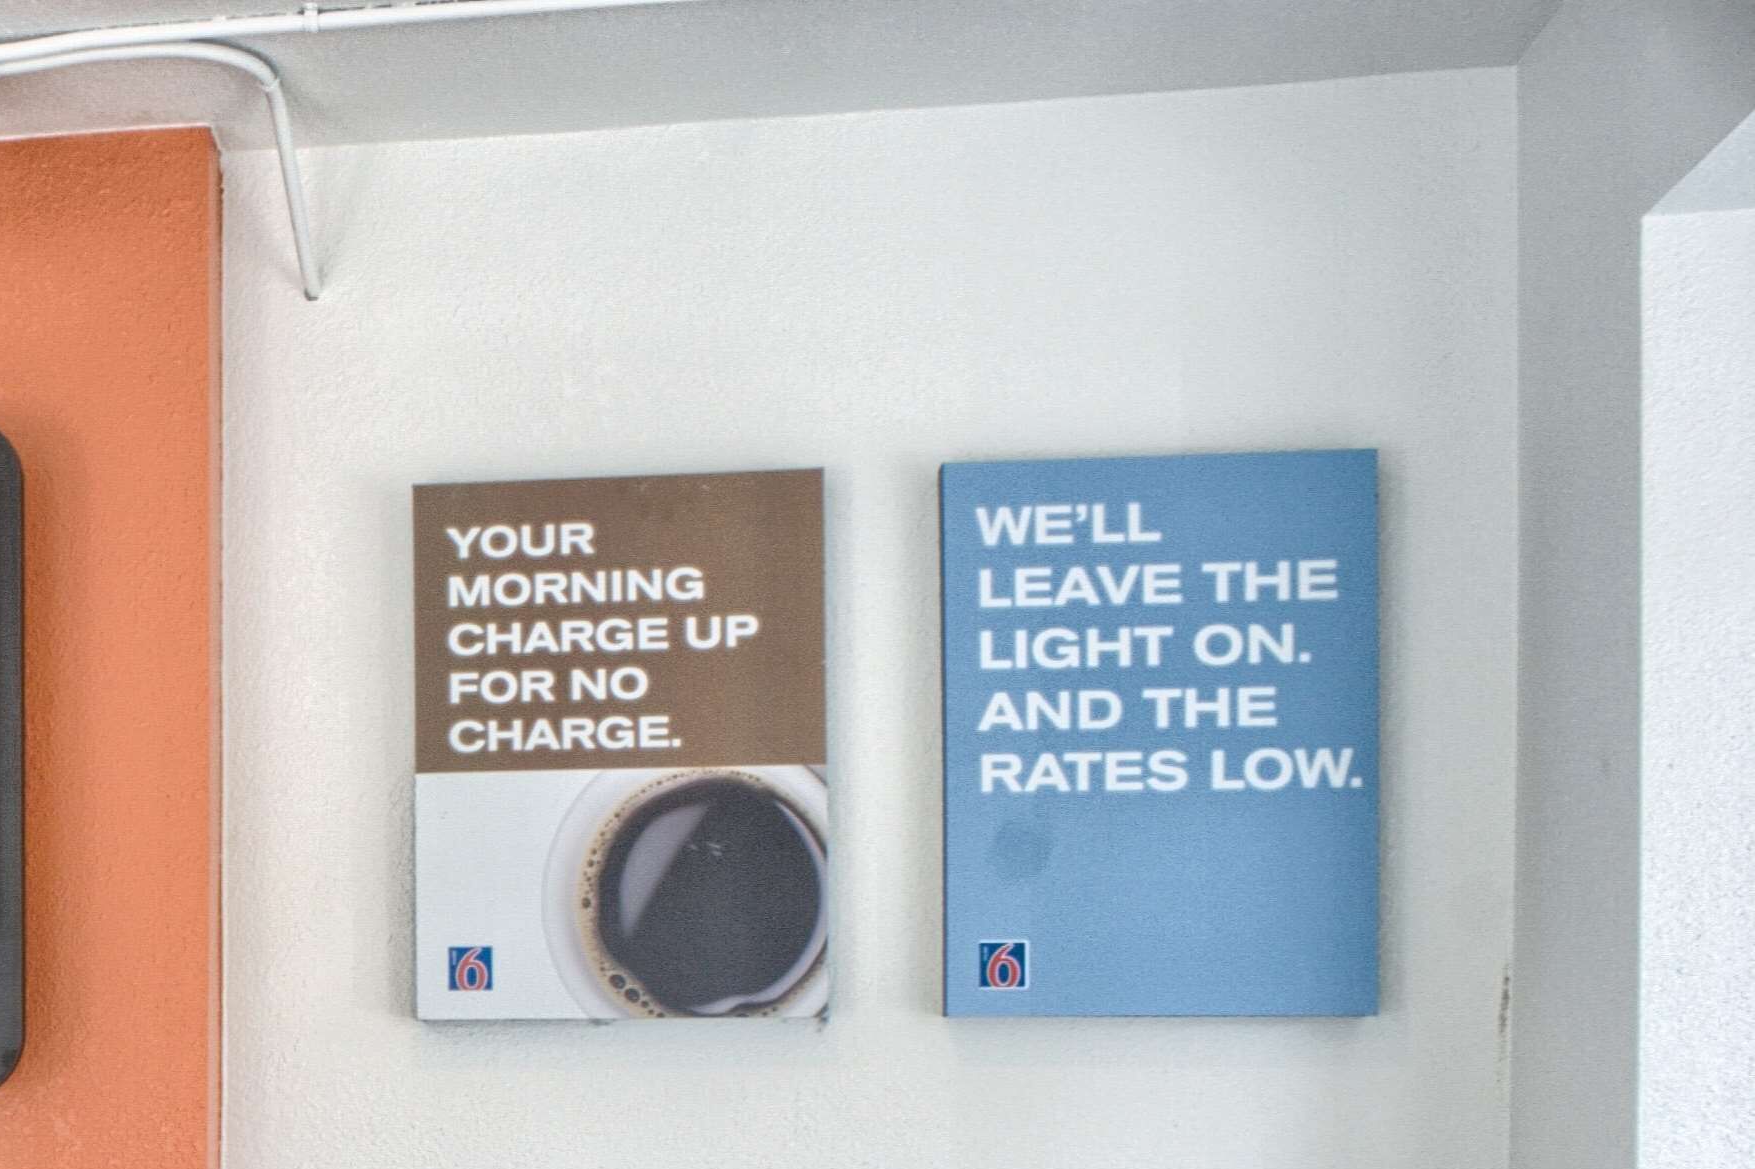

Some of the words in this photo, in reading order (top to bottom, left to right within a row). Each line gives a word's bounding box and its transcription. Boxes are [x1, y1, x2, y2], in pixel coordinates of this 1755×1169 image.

[447, 522, 594, 559] YOUR
[975, 502, 1162, 545] WE'LL
[448, 566, 705, 607] MORNING
[978, 564, 1183, 608] LEAVE
[1201, 559, 1339, 602] THE
[448, 617, 669, 656] CHARGE
[684, 614, 760, 649] UP
[979, 625, 1174, 669] LIGHT
[1192, 622, 1312, 665] ON.
[449, 669, 555, 704] FOR
[570, 666, 648, 701] NO
[976, 690, 1122, 731] AND
[1141, 686, 1278, 728] THE
[448, 714, 682, 753] CHARGE.
[980, 750, 1188, 793] RATES
[1210, 747, 1364, 792] LOW.
[455, 947, 489, 991] 6
[986, 943, 1022, 988] 6
